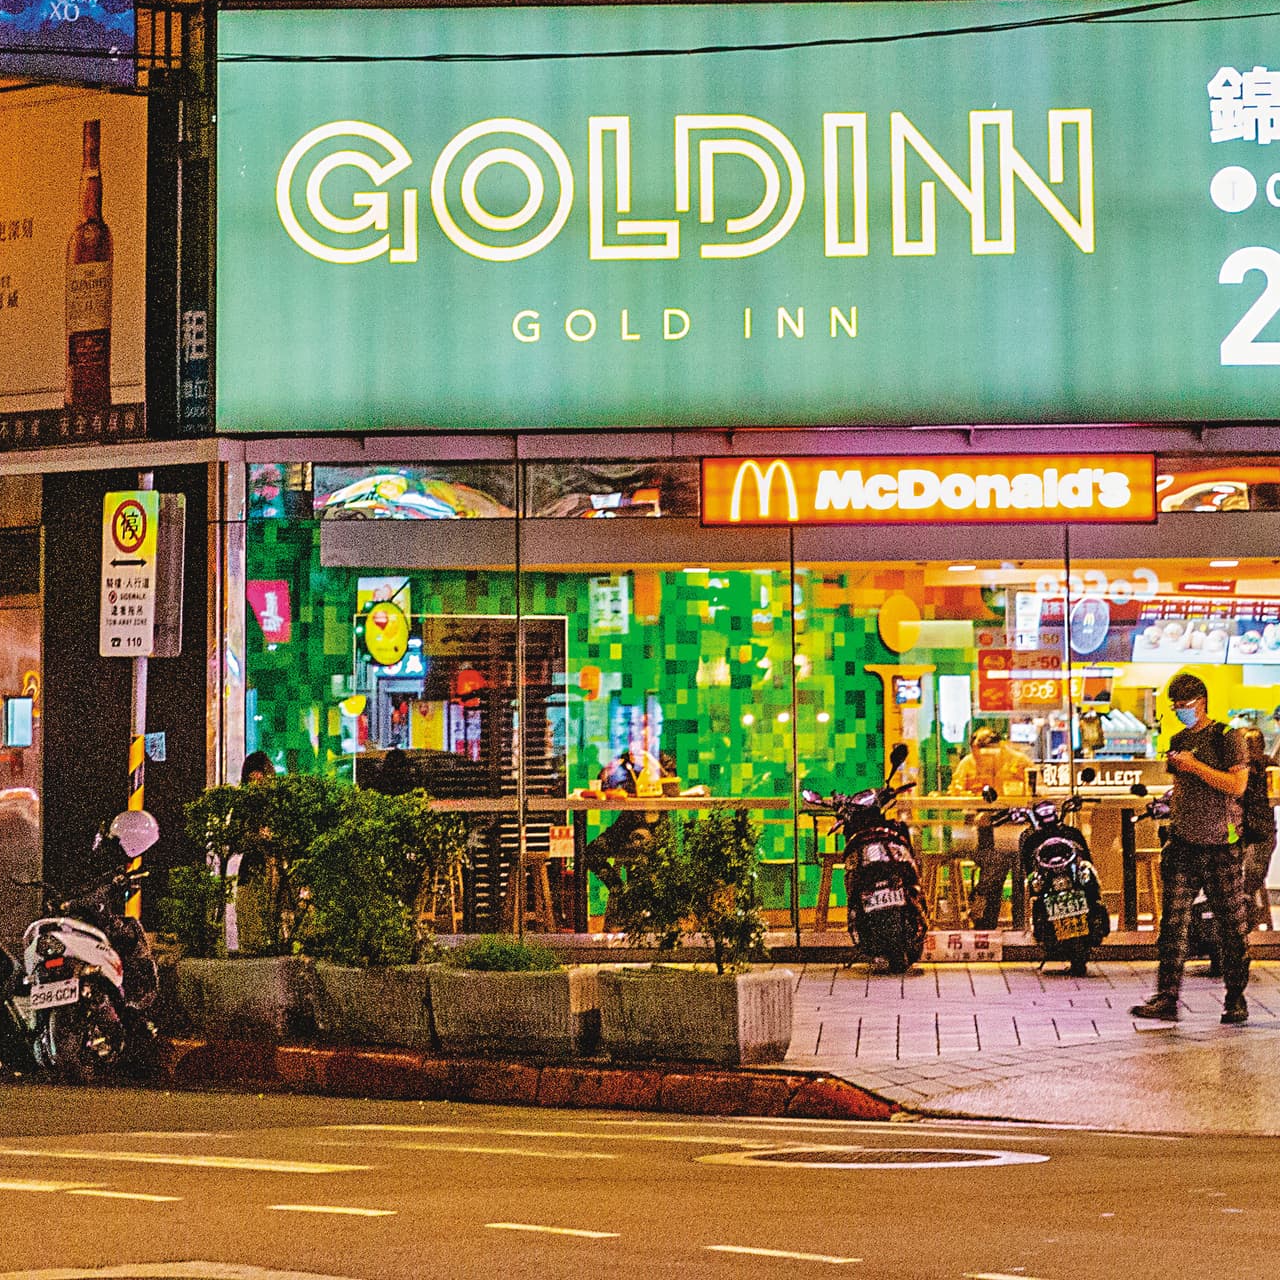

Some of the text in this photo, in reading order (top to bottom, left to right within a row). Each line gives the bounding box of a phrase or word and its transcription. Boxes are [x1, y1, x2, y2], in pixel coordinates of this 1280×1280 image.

[511, 305, 861, 343] GOLD INN
[814, 467, 1131, 511] McDonald's
[127, 637, 142, 647] 110
